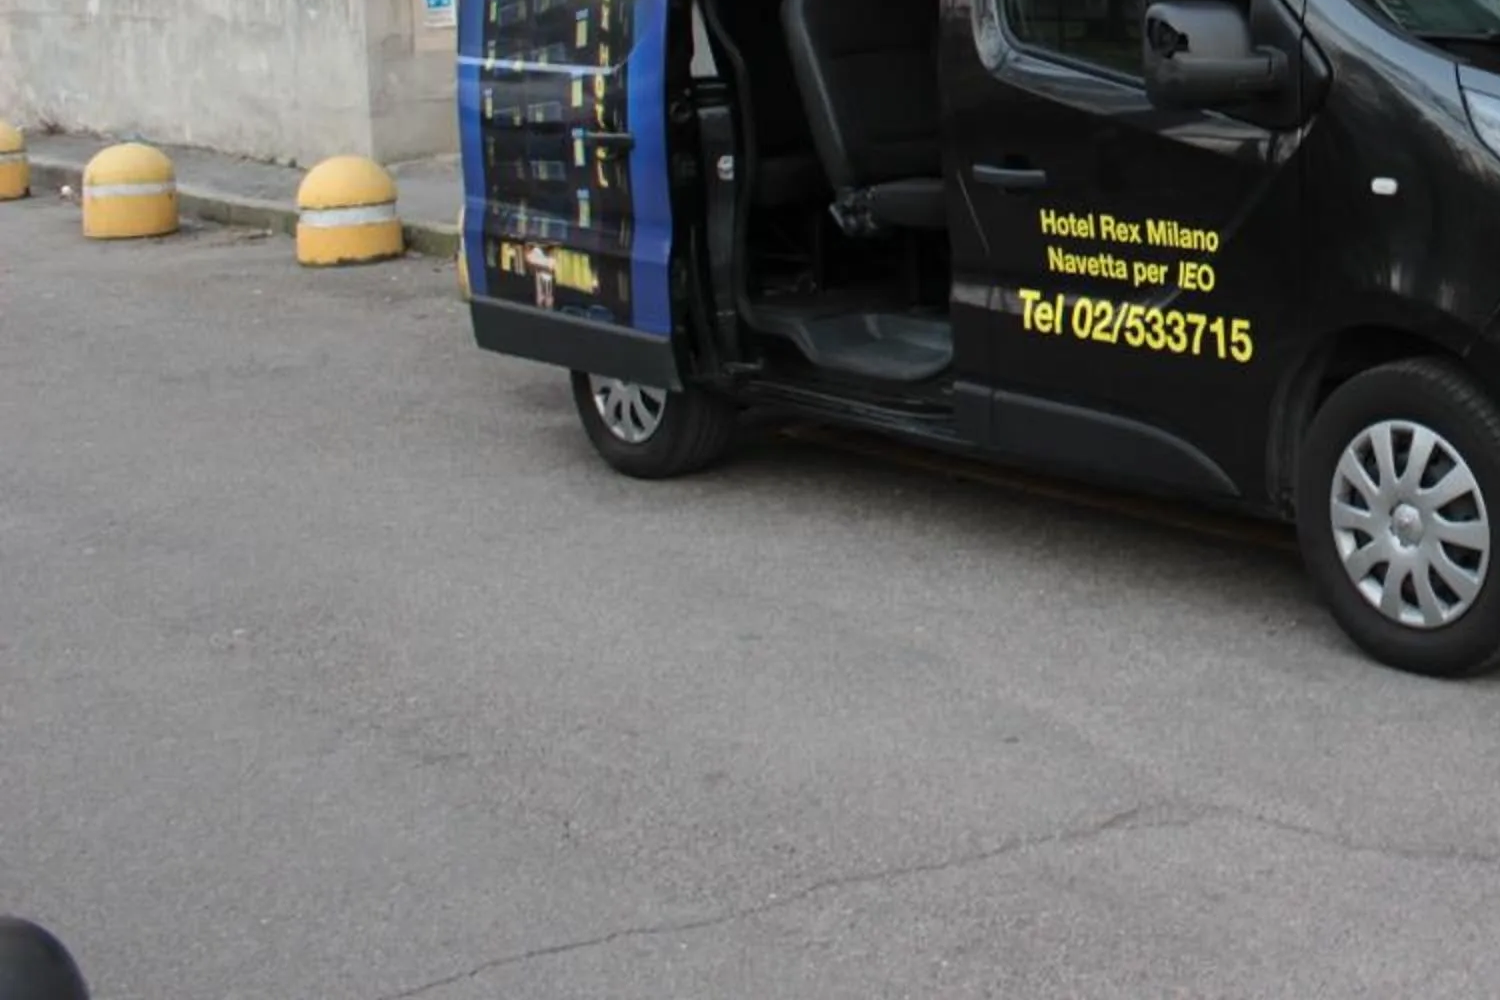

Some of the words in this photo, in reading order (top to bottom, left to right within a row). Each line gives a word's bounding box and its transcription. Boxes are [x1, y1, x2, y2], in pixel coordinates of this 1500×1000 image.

[1040, 207, 1095, 239] Hotel
[1099, 214, 1142, 244] Rex
[1145, 218, 1219, 252] Milano
[1047, 246, 1128, 280] Navetta
[1133, 261, 1168, 287] per
[1177, 261, 1216, 292] IEO
[1018, 288, 1064, 335] Tel
[1071, 296, 1254, 363] 02/533715
